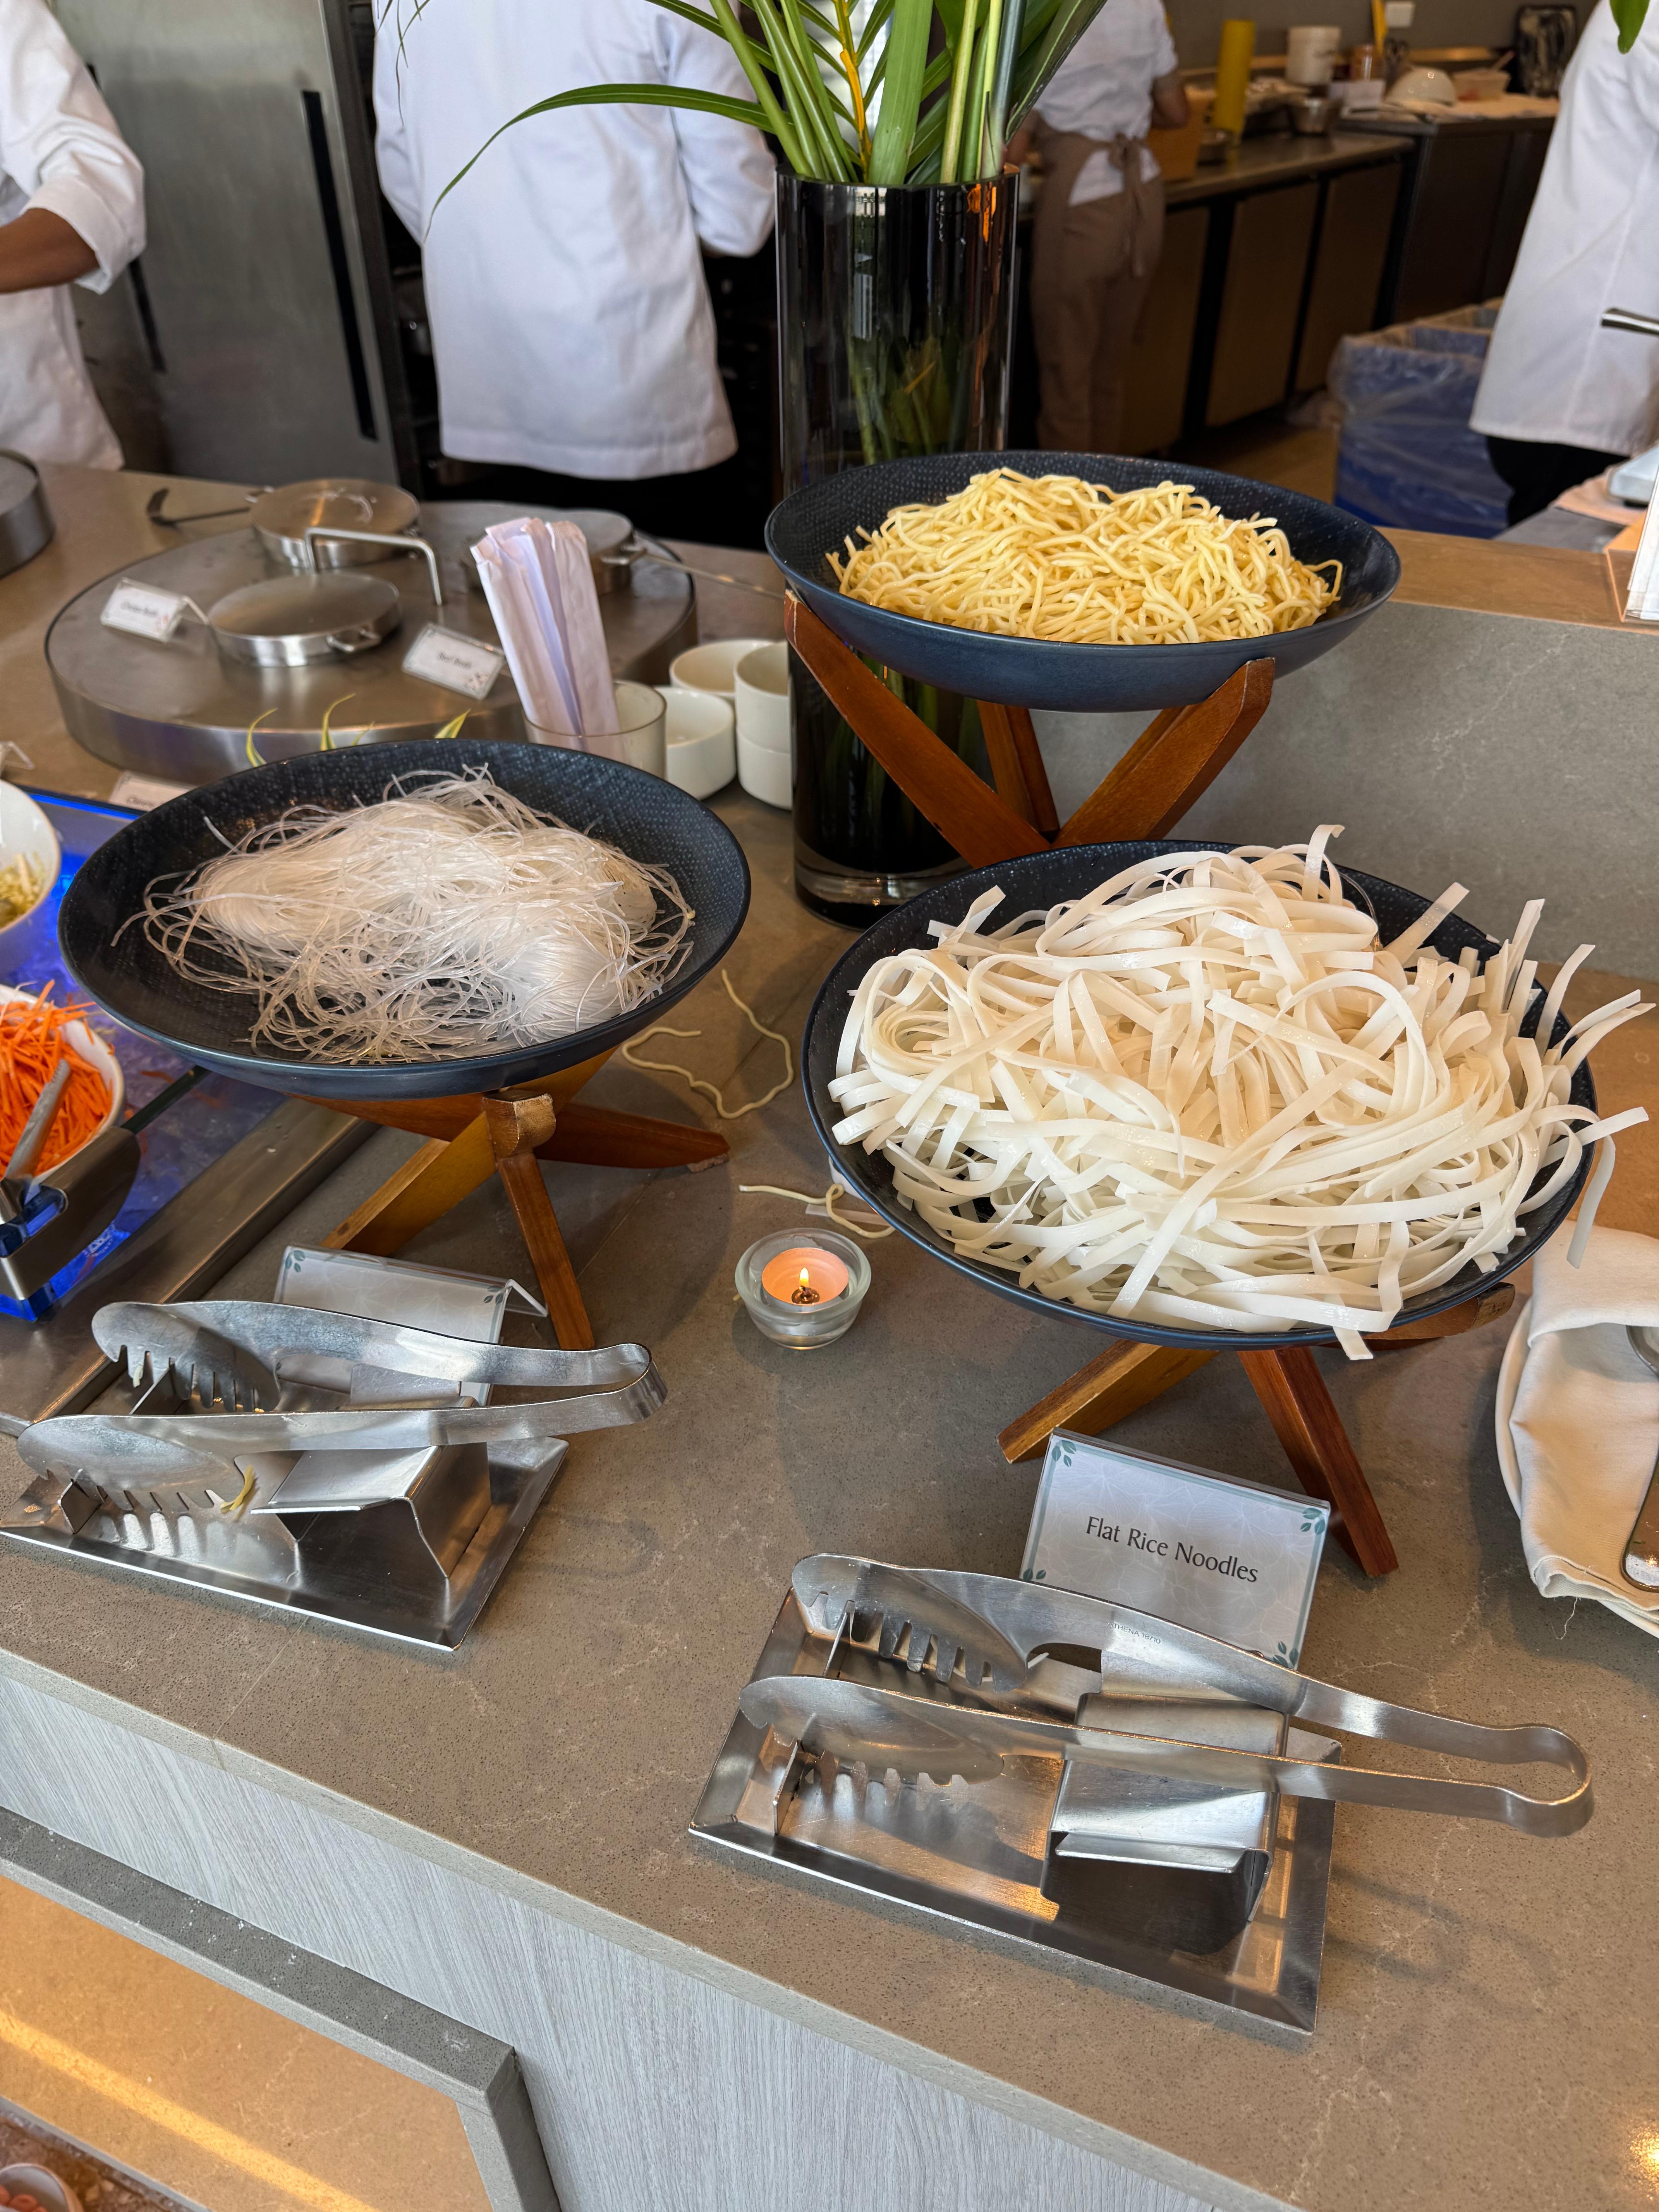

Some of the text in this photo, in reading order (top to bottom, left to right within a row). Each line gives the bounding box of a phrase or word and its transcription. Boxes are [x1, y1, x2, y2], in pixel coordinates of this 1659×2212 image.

[1086, 1516, 1258, 1583] Flat Rice Noodles
[1108, 1622, 1161, 1644] ATHENA 18/10
